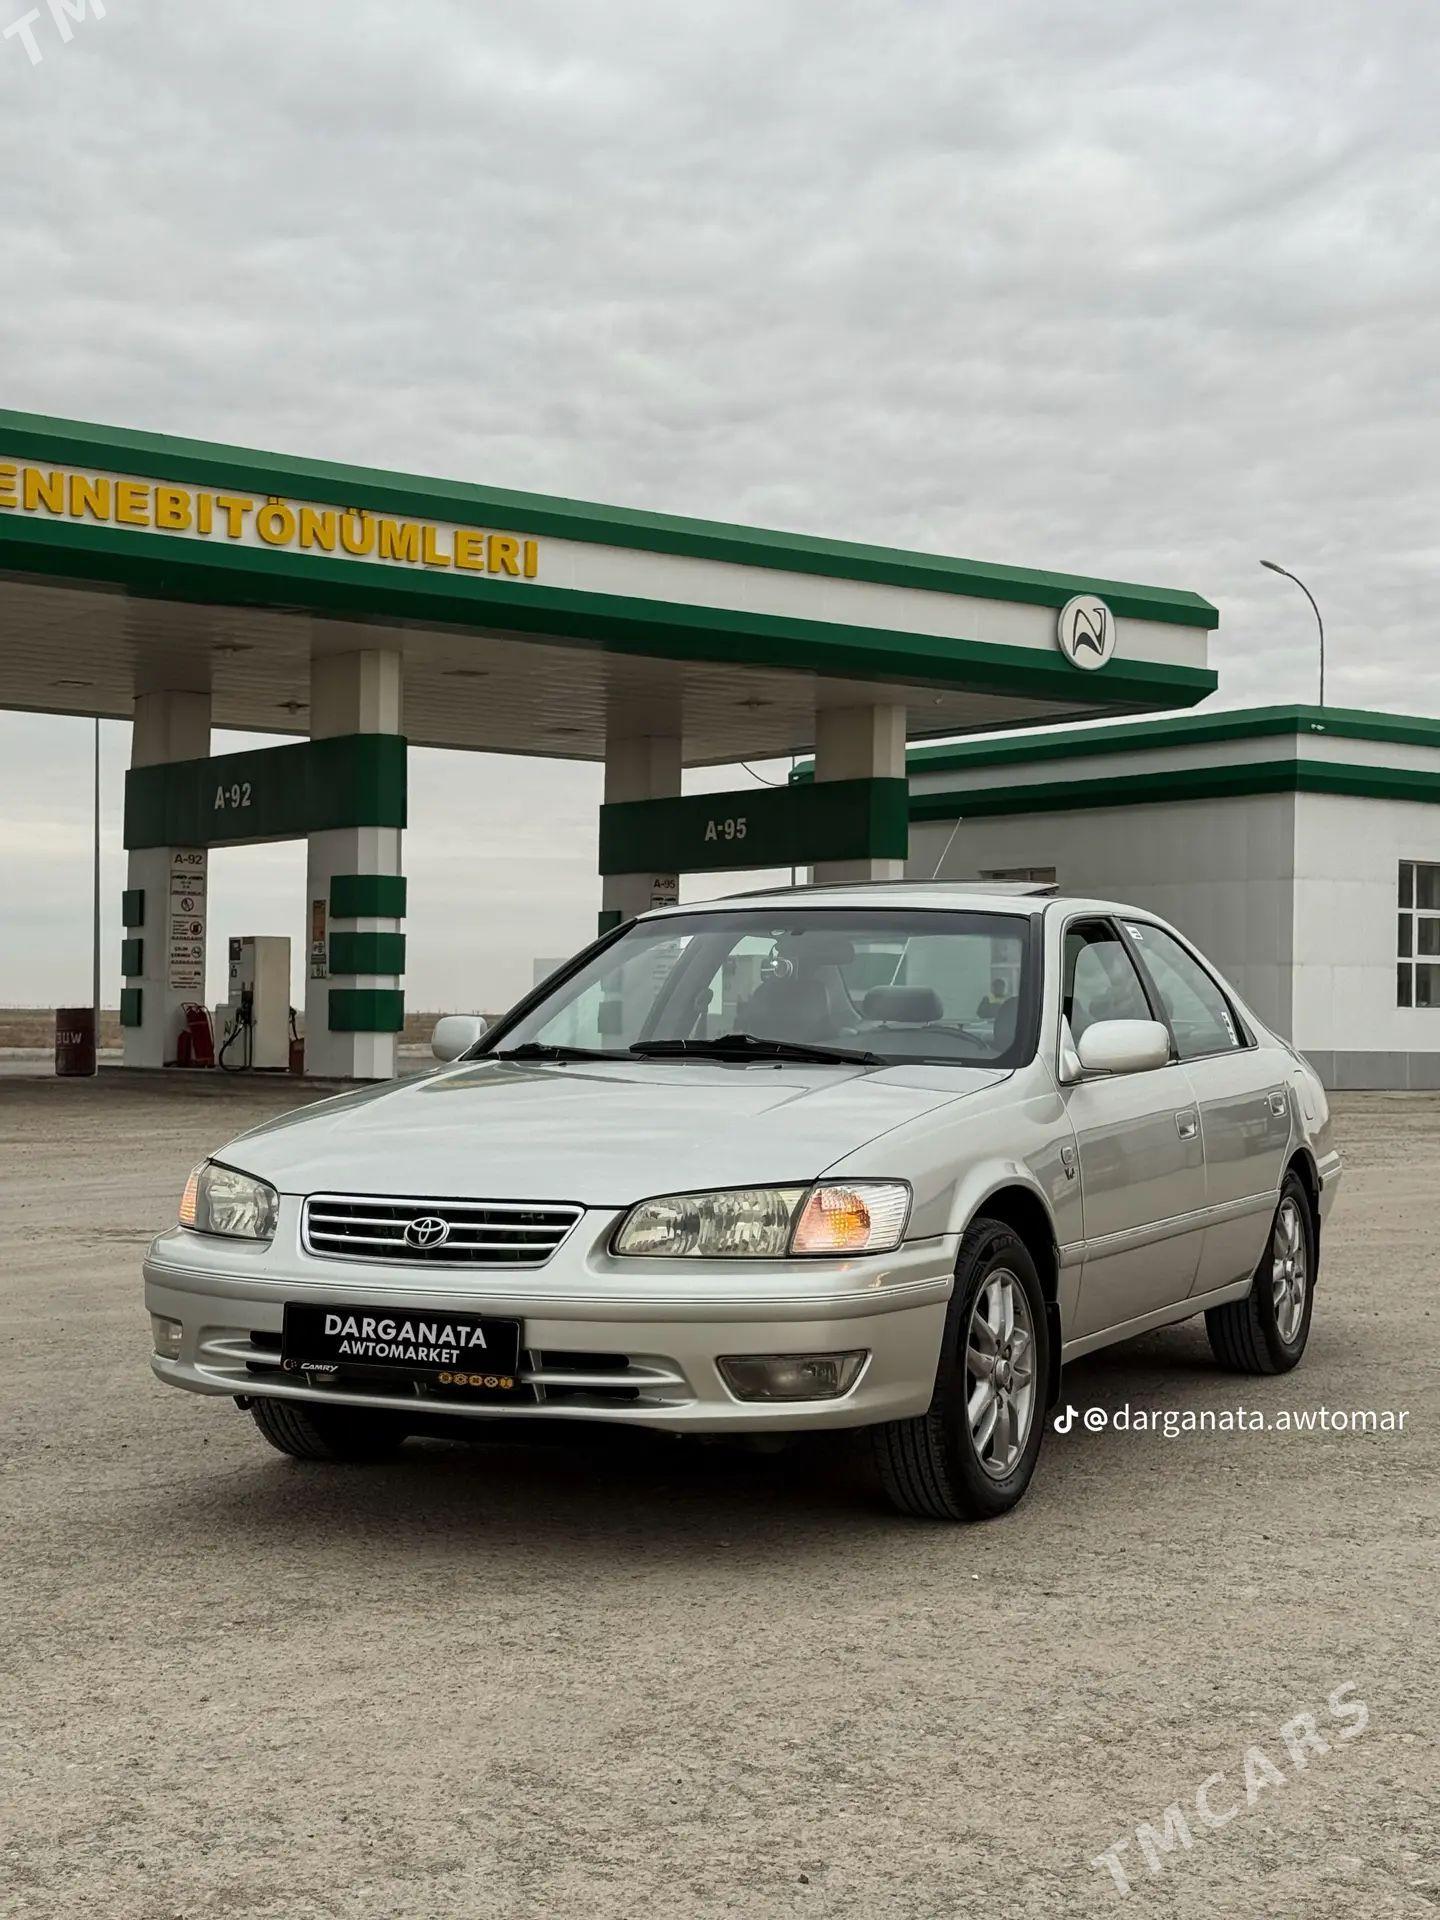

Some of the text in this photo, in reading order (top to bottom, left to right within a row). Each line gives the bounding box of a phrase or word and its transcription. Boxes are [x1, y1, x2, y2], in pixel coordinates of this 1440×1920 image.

[214, 782, 252, 810] A-92
[704, 817, 748, 841] A-95
[174, 854, 203, 865] A-92
[324, 1314, 487, 1349] DARGANATA
[338, 1340, 460, 1364] AWTOMARKET
[300, 1362, 339, 1373] CAMRY
